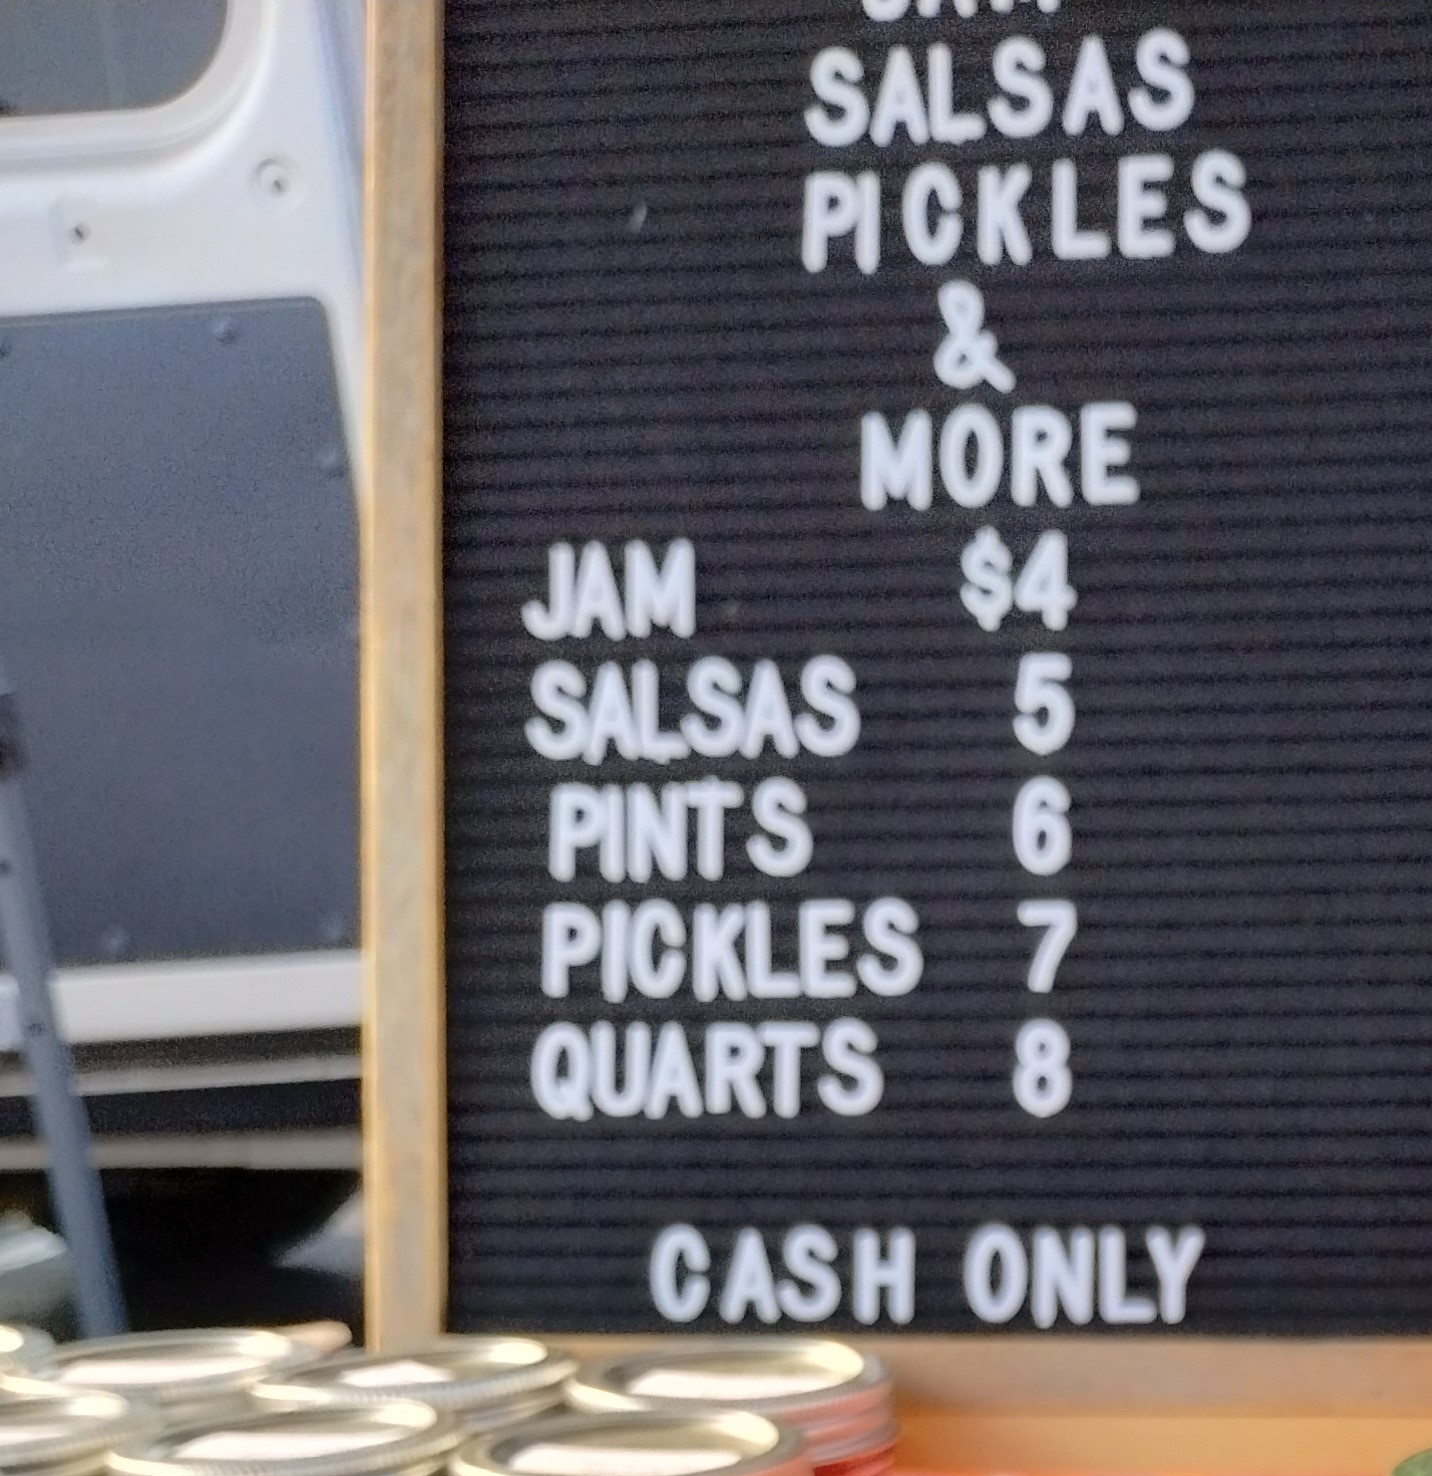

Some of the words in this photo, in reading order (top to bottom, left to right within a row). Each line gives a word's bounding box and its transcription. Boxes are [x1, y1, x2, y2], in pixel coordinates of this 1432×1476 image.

[804, 29, 1194, 147] SALSAS
[801, 150, 1251, 275] PICKLES
[933, 280, 1015, 393] &
[860, 402, 1139, 511] MORE
[522, 539, 696, 641] JAM
[960, 526, 1076, 632] $4
[525, 655, 860, 766] SALSAS
[1013, 652, 1075, 756] 5
[549, 775, 813, 883] PINTS
[1012, 776, 1072, 876] 6
[541, 897, 923, 1003] PICKLES
[1016, 900, 1077, 993] 7
[530, 1017, 883, 1121] QUARTS
[1012, 1019, 1072, 1118] 8
[650, 1225, 915, 1323] CASH
[964, 1225, 1204, 1328] ONLY
